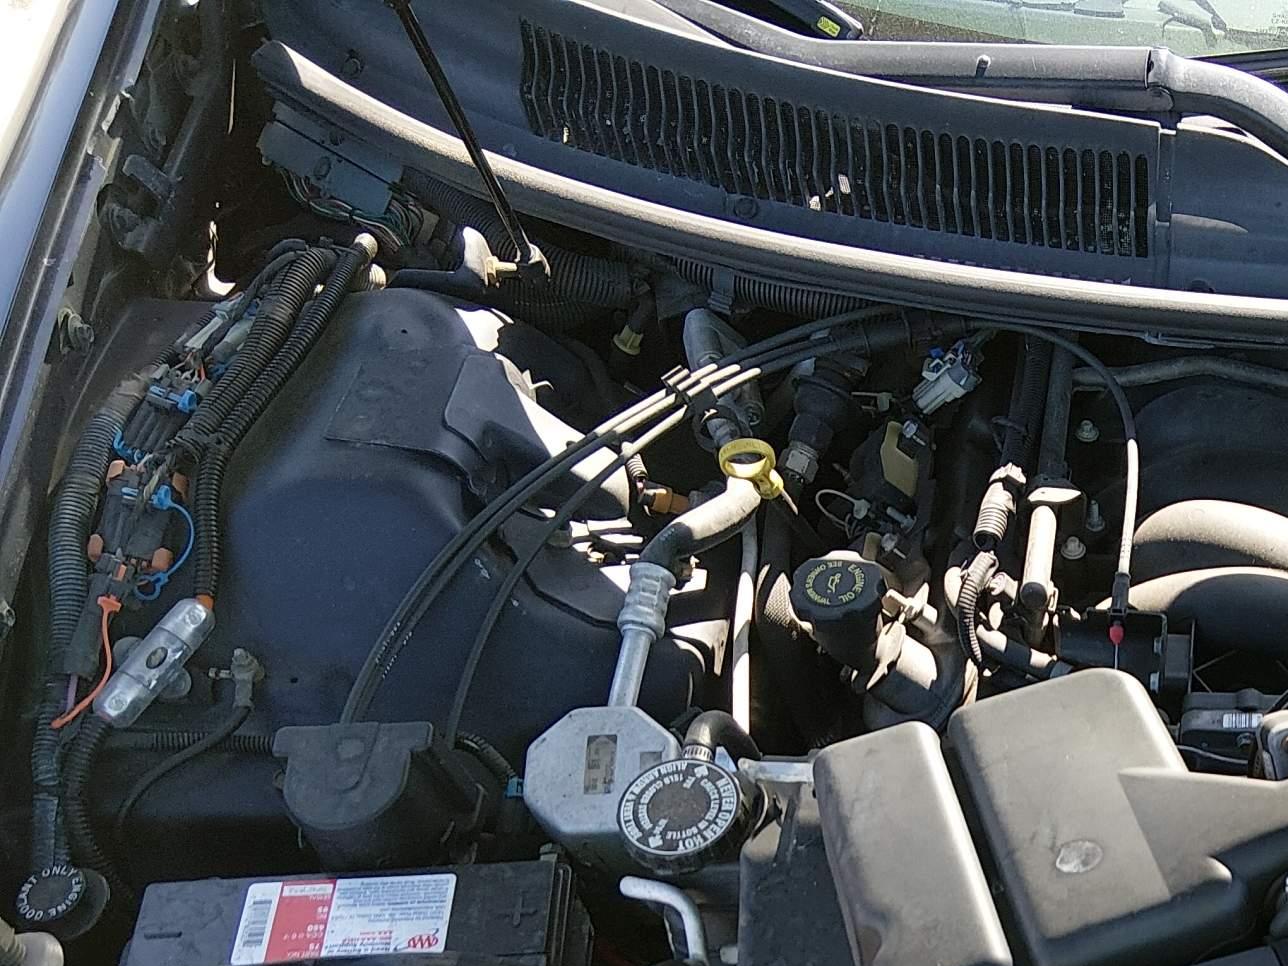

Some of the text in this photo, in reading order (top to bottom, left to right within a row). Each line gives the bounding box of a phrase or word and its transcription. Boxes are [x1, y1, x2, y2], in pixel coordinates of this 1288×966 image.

[838, 563, 865, 603] ENGINE OIL
[632, 769, 660, 795] ARROW
[659, 761, 688, 775] ALIGN
[677, 777, 736, 852] NEVER OPEN HOT
[17, 865, 82, 921] ENGINE COOLANT ONLY
